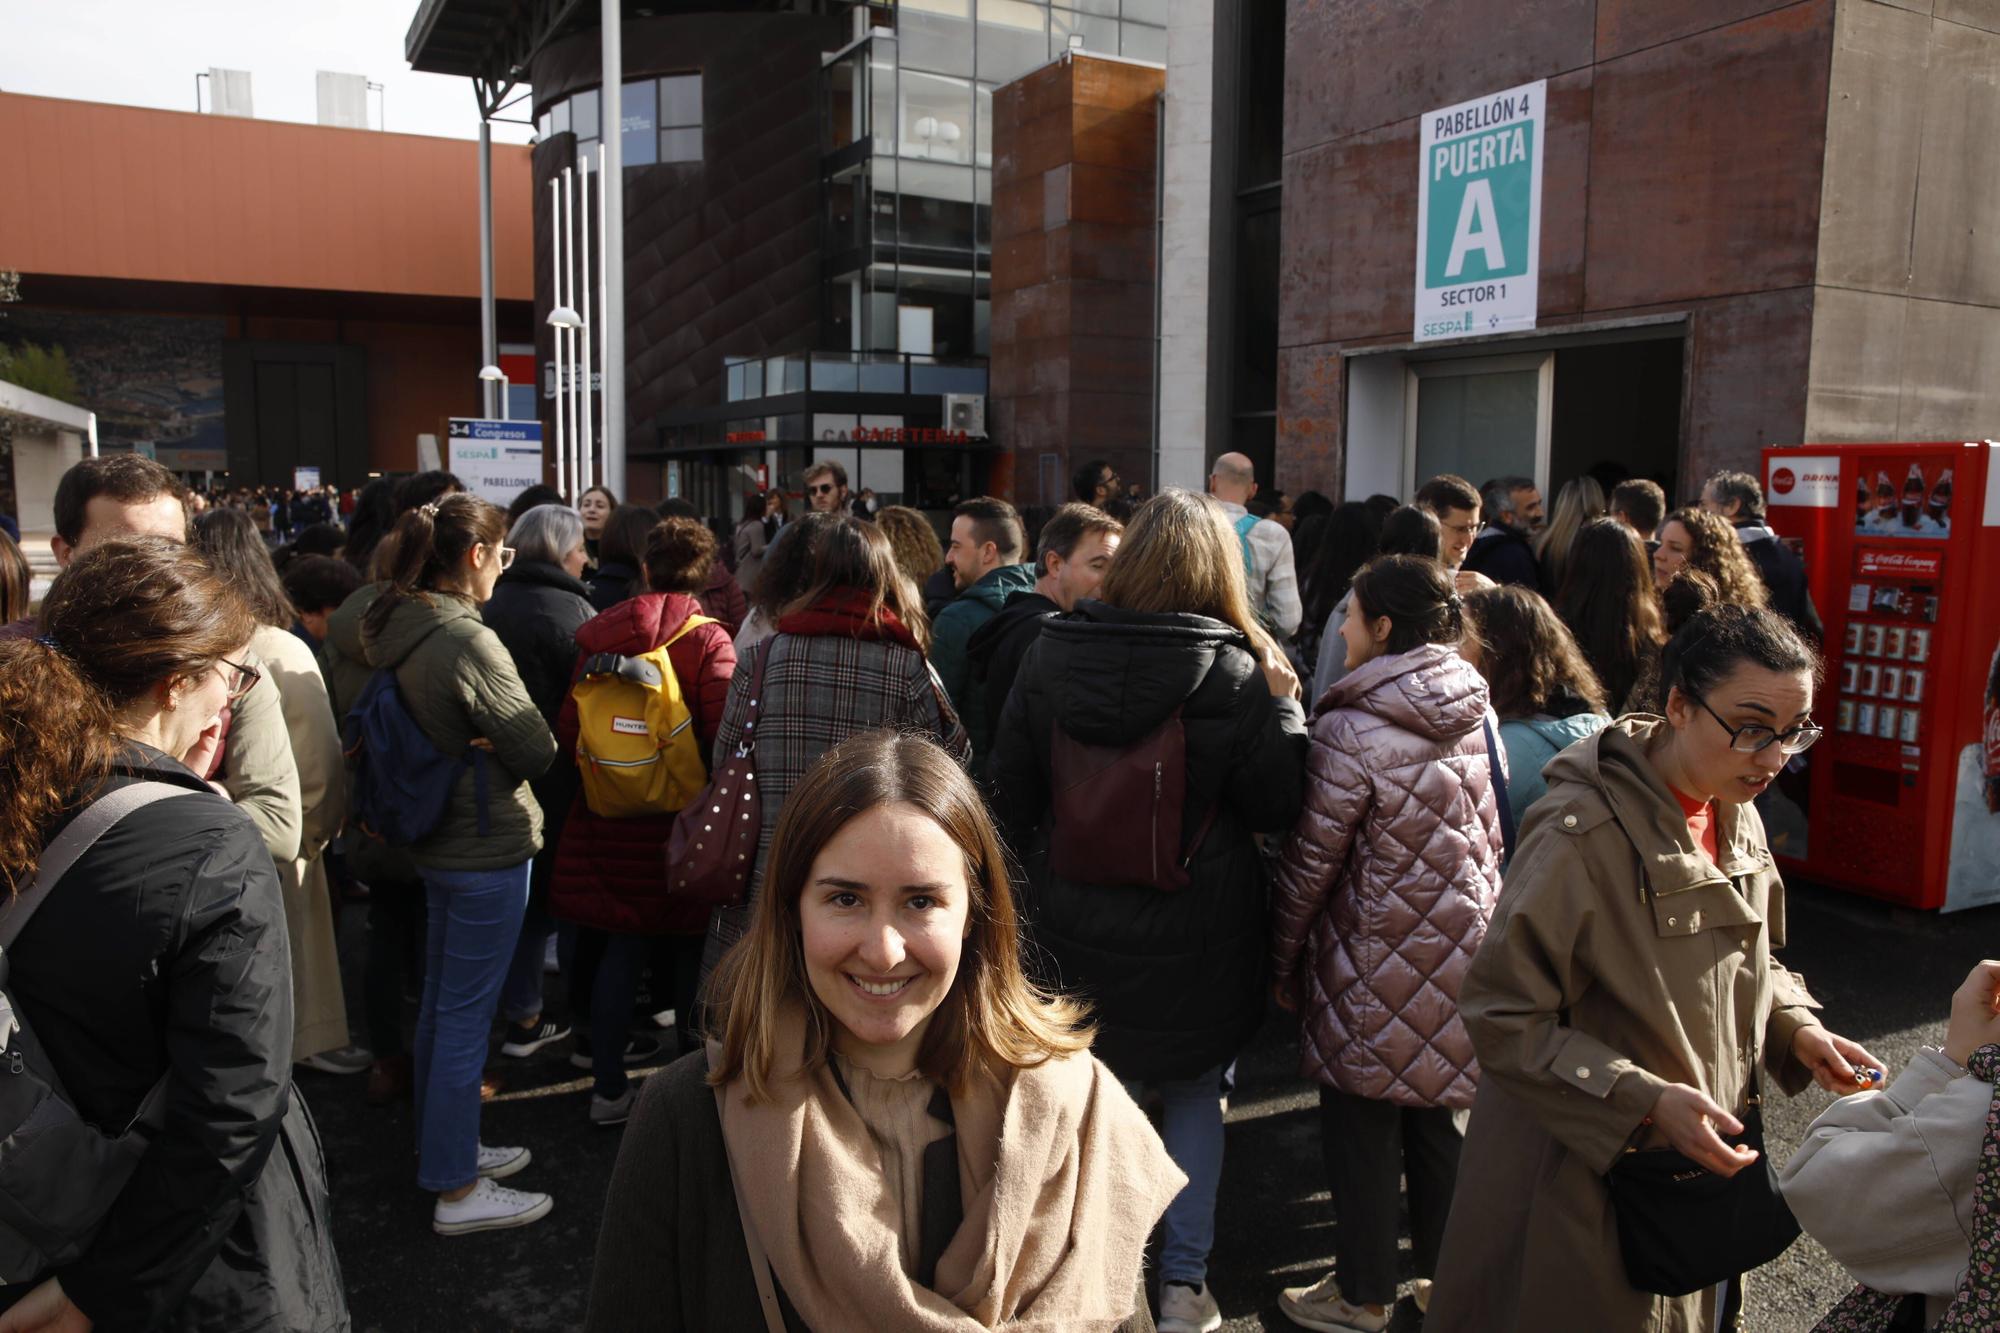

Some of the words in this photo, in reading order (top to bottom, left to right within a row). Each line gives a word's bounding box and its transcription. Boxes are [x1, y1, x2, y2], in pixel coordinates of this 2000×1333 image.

[1435, 97, 1514, 139] PABELLÓN
[1519, 94, 1530, 115] 4
[1435, 127, 1526, 182] PUERTA
[1444, 178, 1506, 278] A
[1441, 285, 1496, 307] SECTOR
[1499, 284, 1507, 299] 1
[1423, 320, 1463, 336] SESPA
[450, 423, 470, 435] 3-4
[474, 428, 526, 440] Congresos
[456, 450, 490, 459] SESPA
